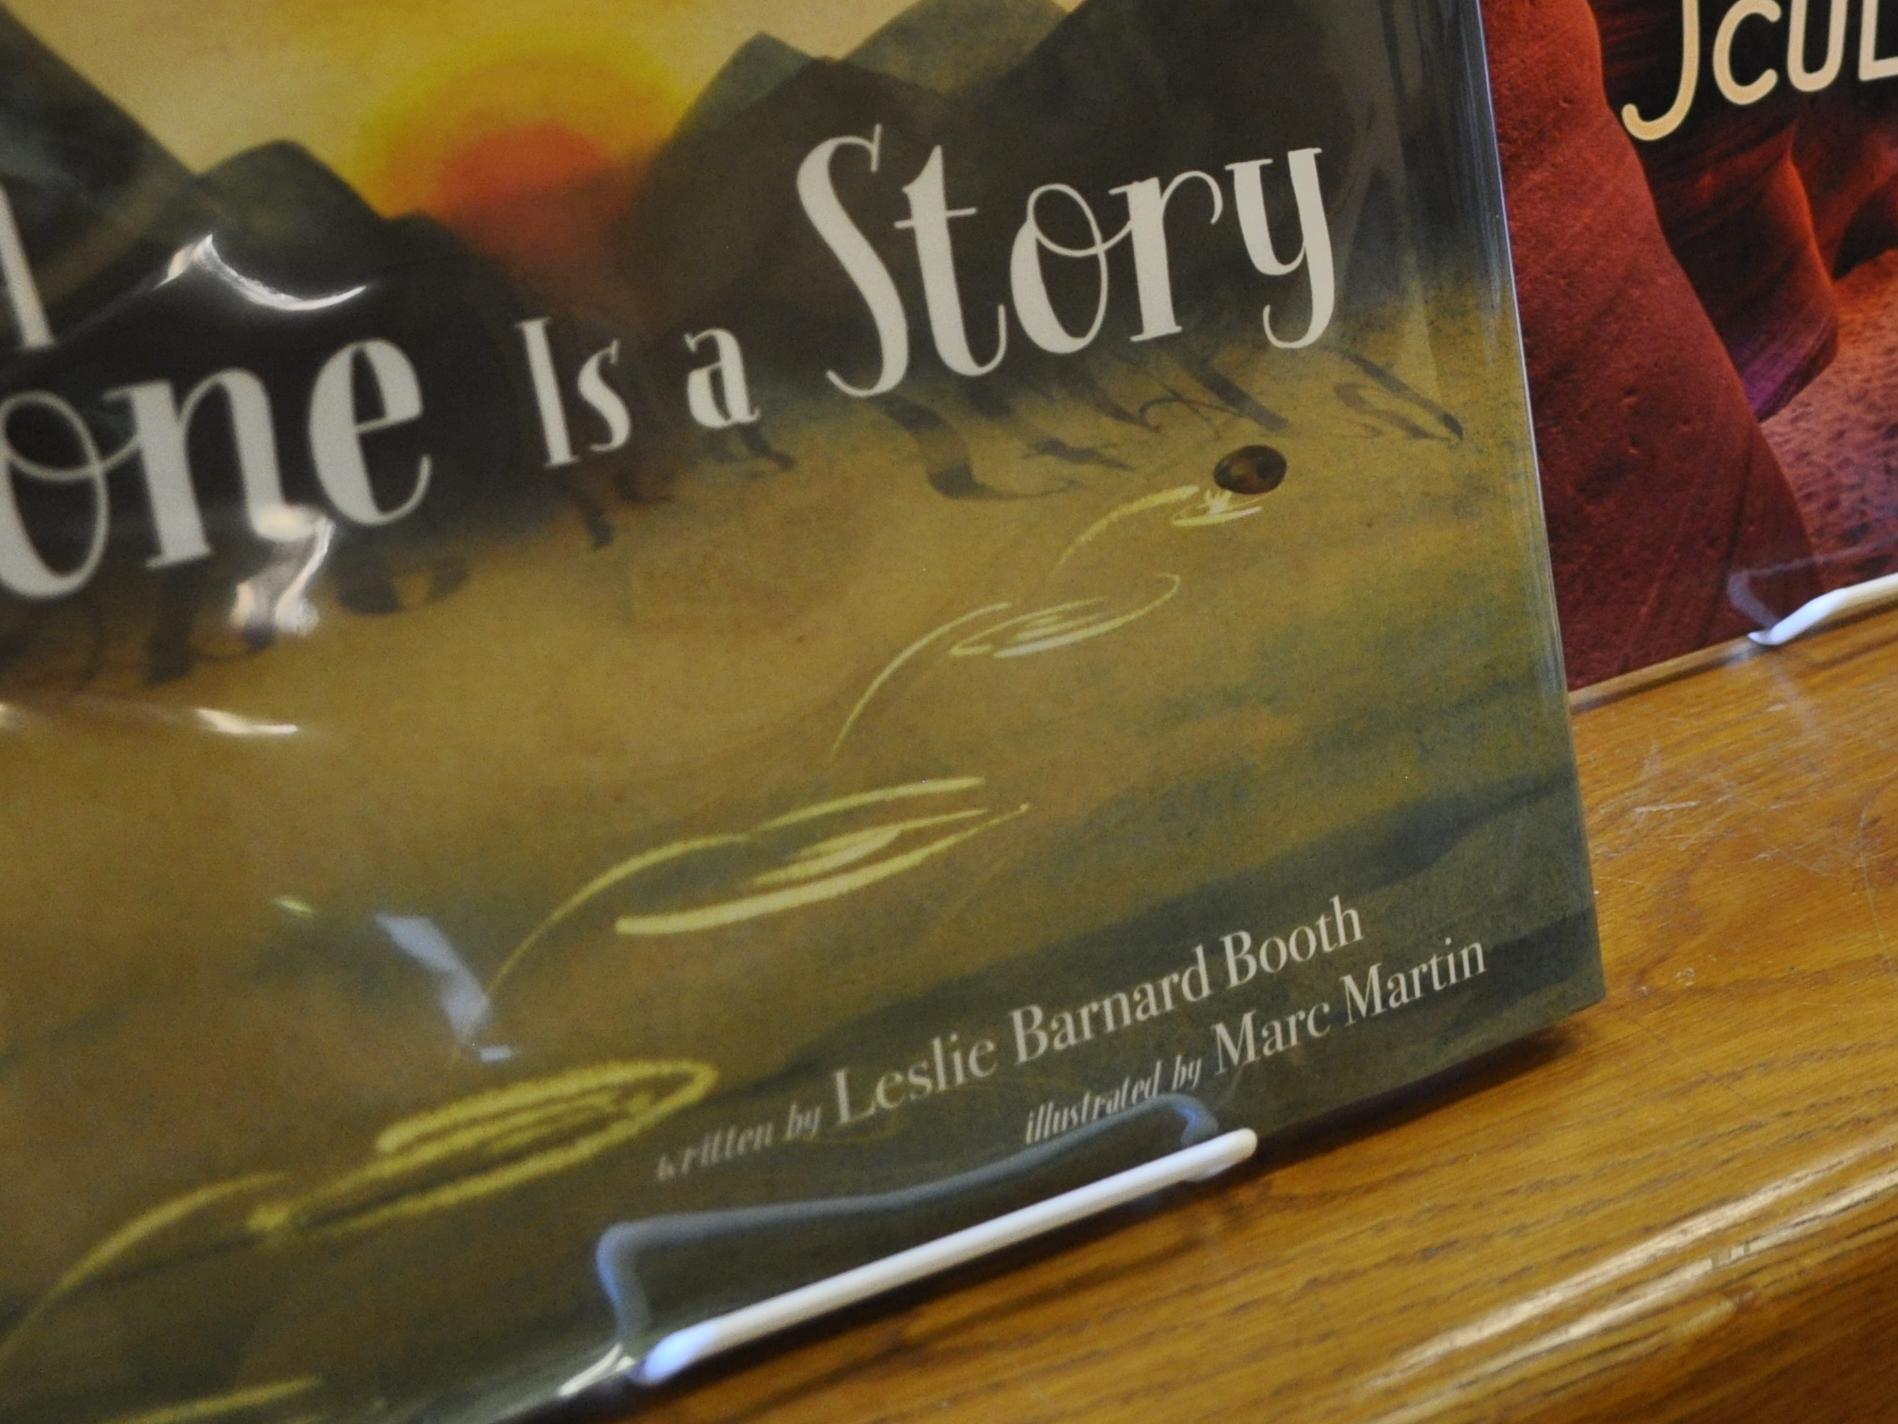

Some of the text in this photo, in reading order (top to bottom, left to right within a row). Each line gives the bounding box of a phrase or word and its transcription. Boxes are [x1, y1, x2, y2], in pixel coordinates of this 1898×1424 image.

[514, 123, 1337, 470] Is a Story
[0, 337, 432, 601] one
[782, 1102, 826, 1144] by
[833, 1030, 1000, 1129] Leslie
[1008, 944, 1212, 1068] Barnard
[1217, 893, 1365, 992] Booth
[1023, 936, 1491, 1146] illustrated by Marc Martin
